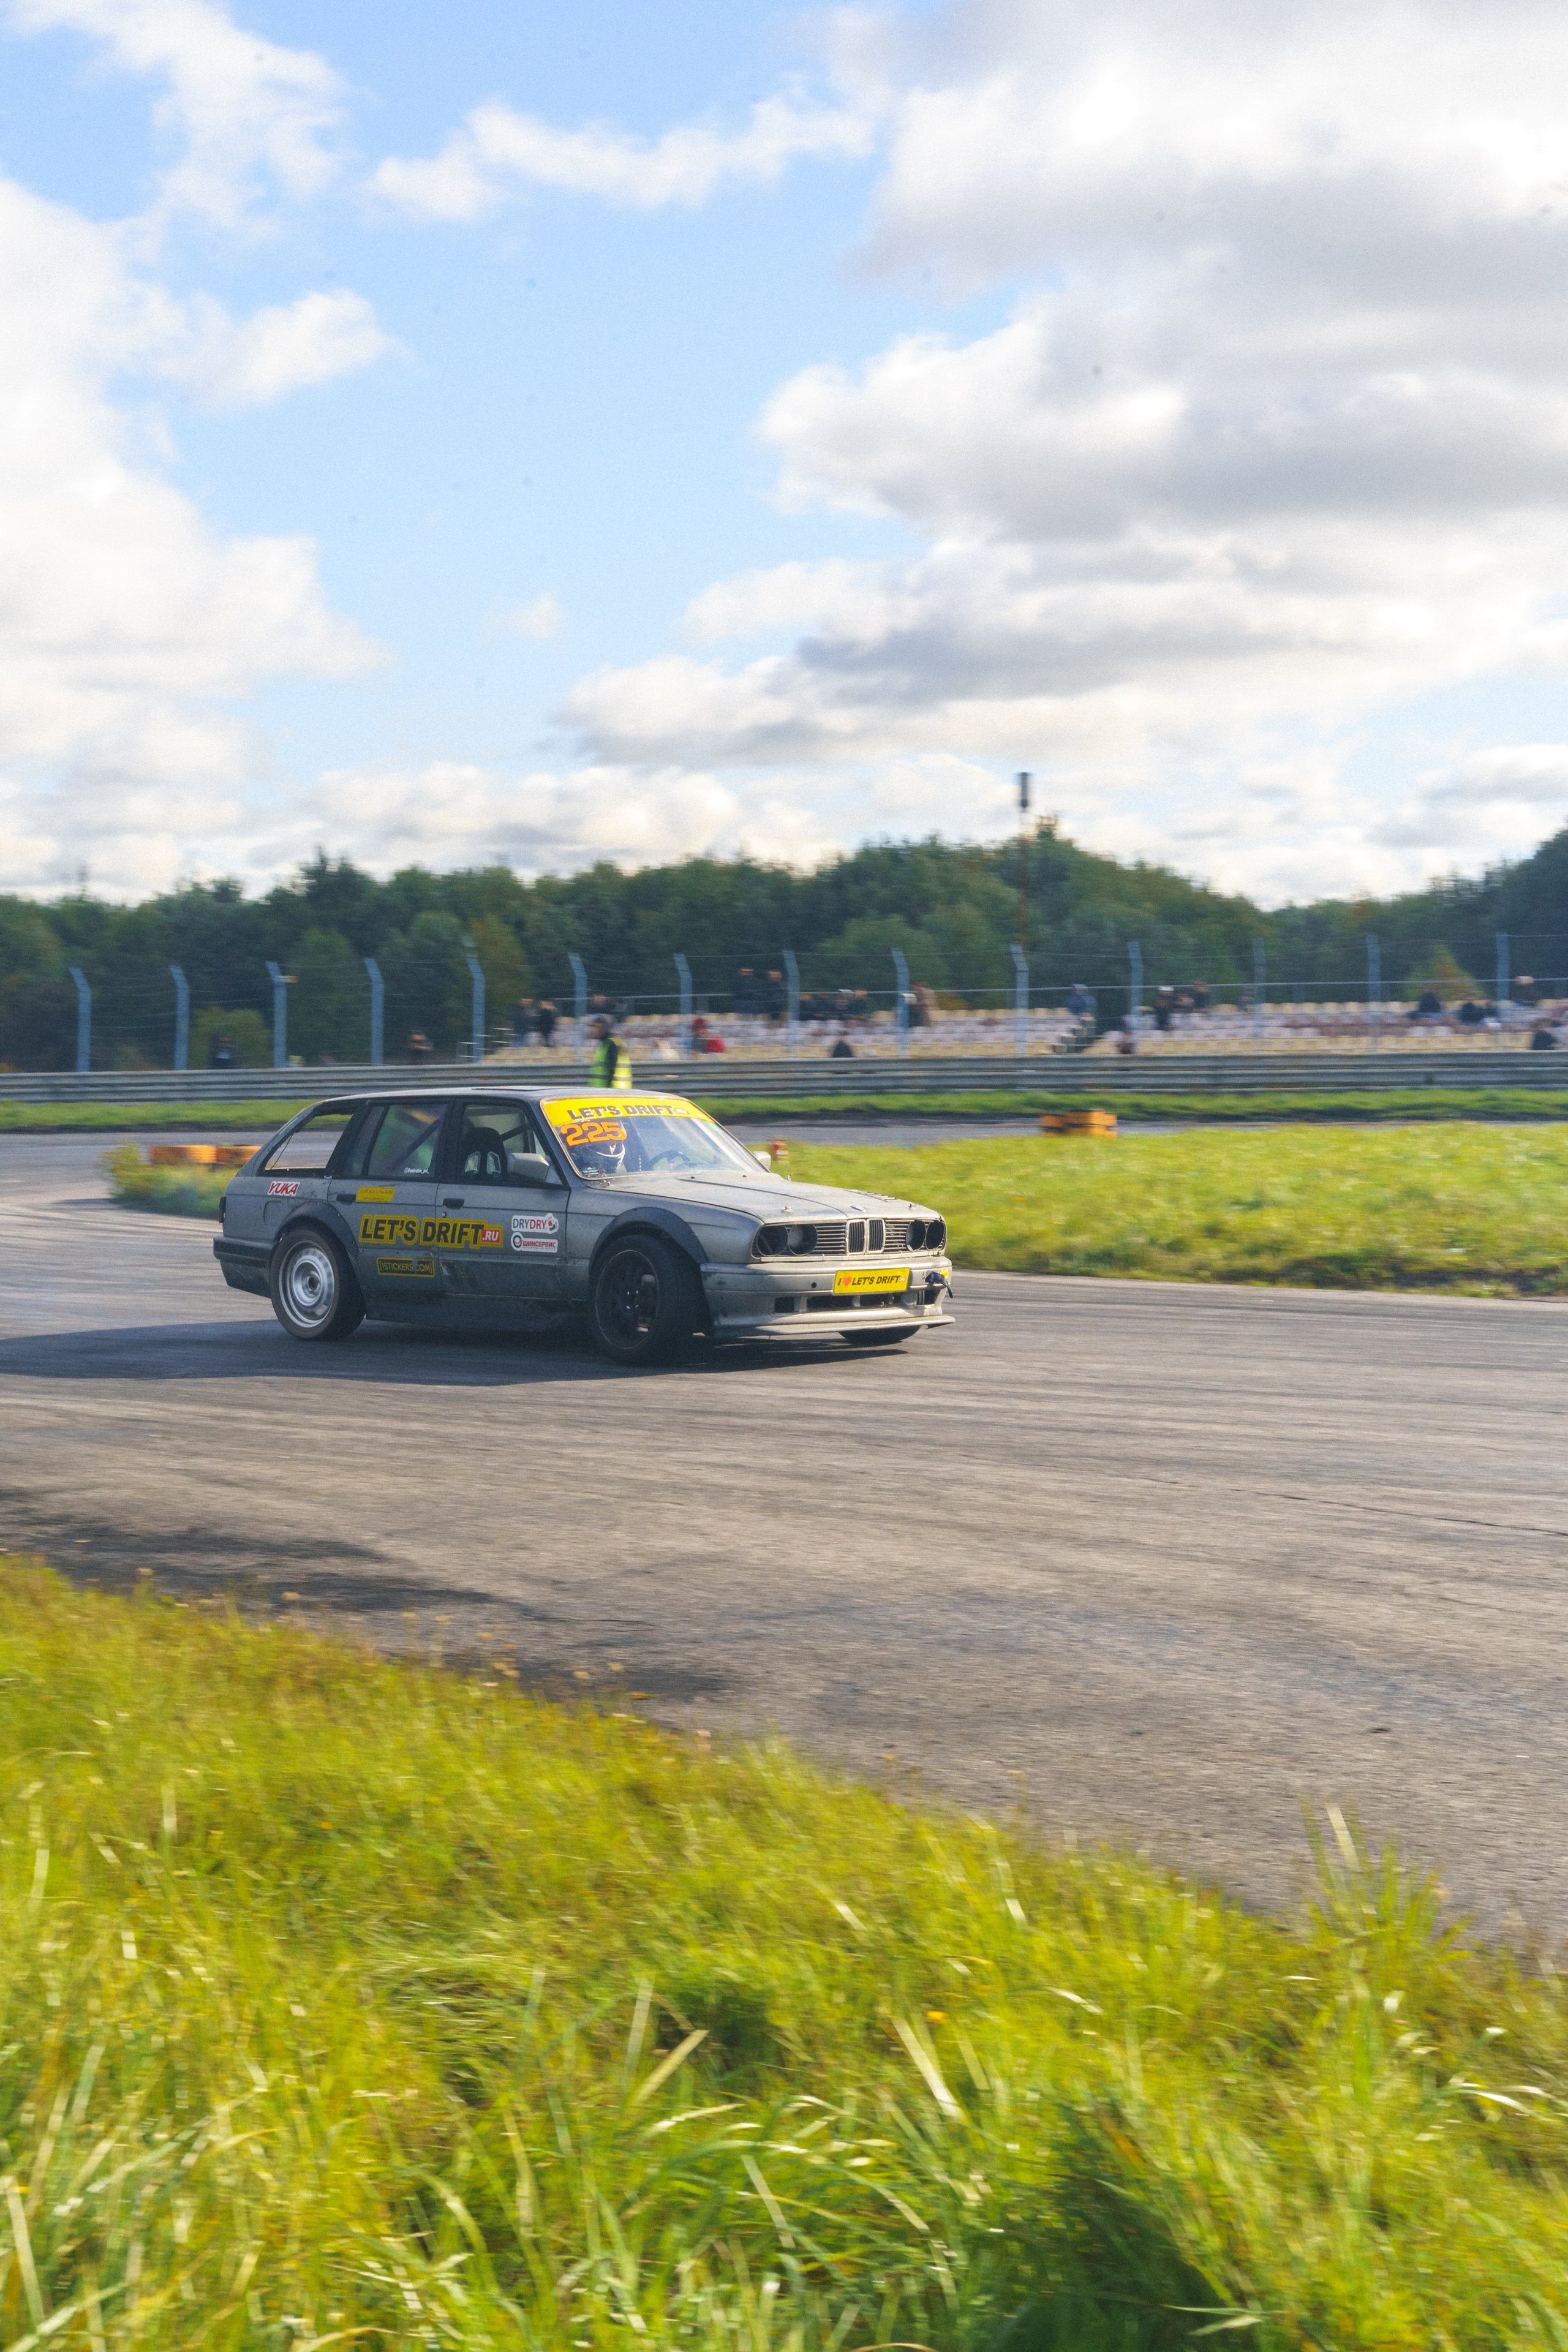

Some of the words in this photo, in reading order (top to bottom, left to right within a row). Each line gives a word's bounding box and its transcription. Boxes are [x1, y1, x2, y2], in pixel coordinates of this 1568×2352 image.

[568, 1106, 622, 1120] LET'S
[560, 1121, 627, 1147] 225
[268, 1182, 299, 1195] YUKA
[361, 1218, 417, 1242] LET'S
[513, 1218, 547, 1231] DRYDRY
[851, 1276, 875, 1286] LET'S
